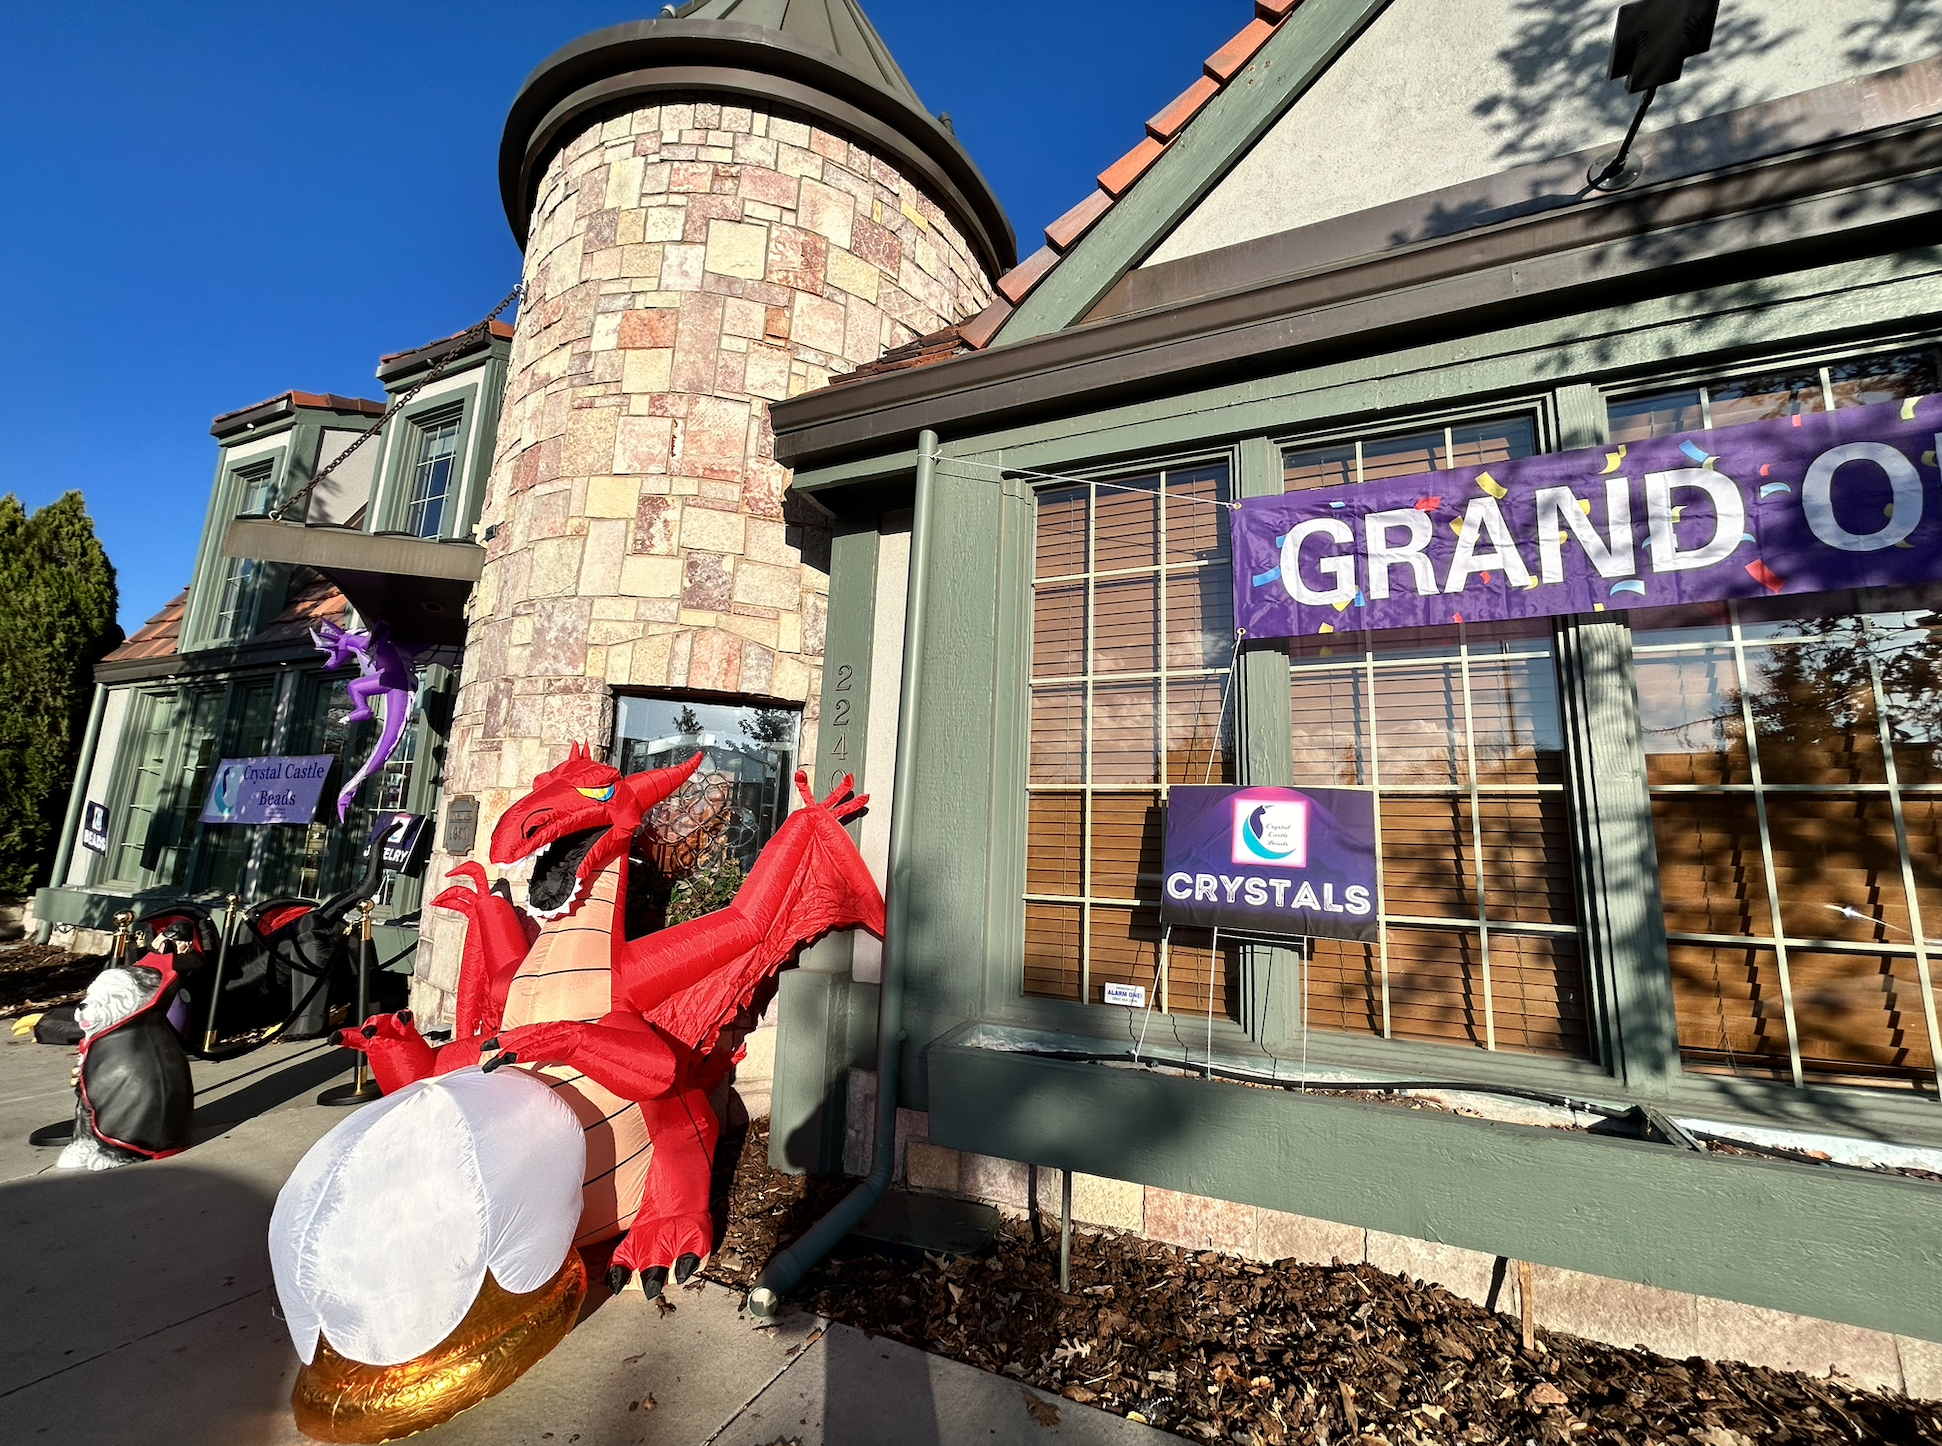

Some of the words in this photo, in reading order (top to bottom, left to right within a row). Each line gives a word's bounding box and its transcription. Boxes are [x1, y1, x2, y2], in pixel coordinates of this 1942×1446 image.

[1280, 467, 1746, 606] GRAND
[1802, 432, 1942, 551] O
[244, 763, 282, 784] Crystal
[285, 762, 325, 779] Castle
[259, 789, 296, 806] Beads
[84, 828, 107, 852] BEADS
[363, 844, 409, 863] JELRY
[1166, 872, 1371, 915] CRYSTALS
[1107, 989, 1127, 997] ALARM
